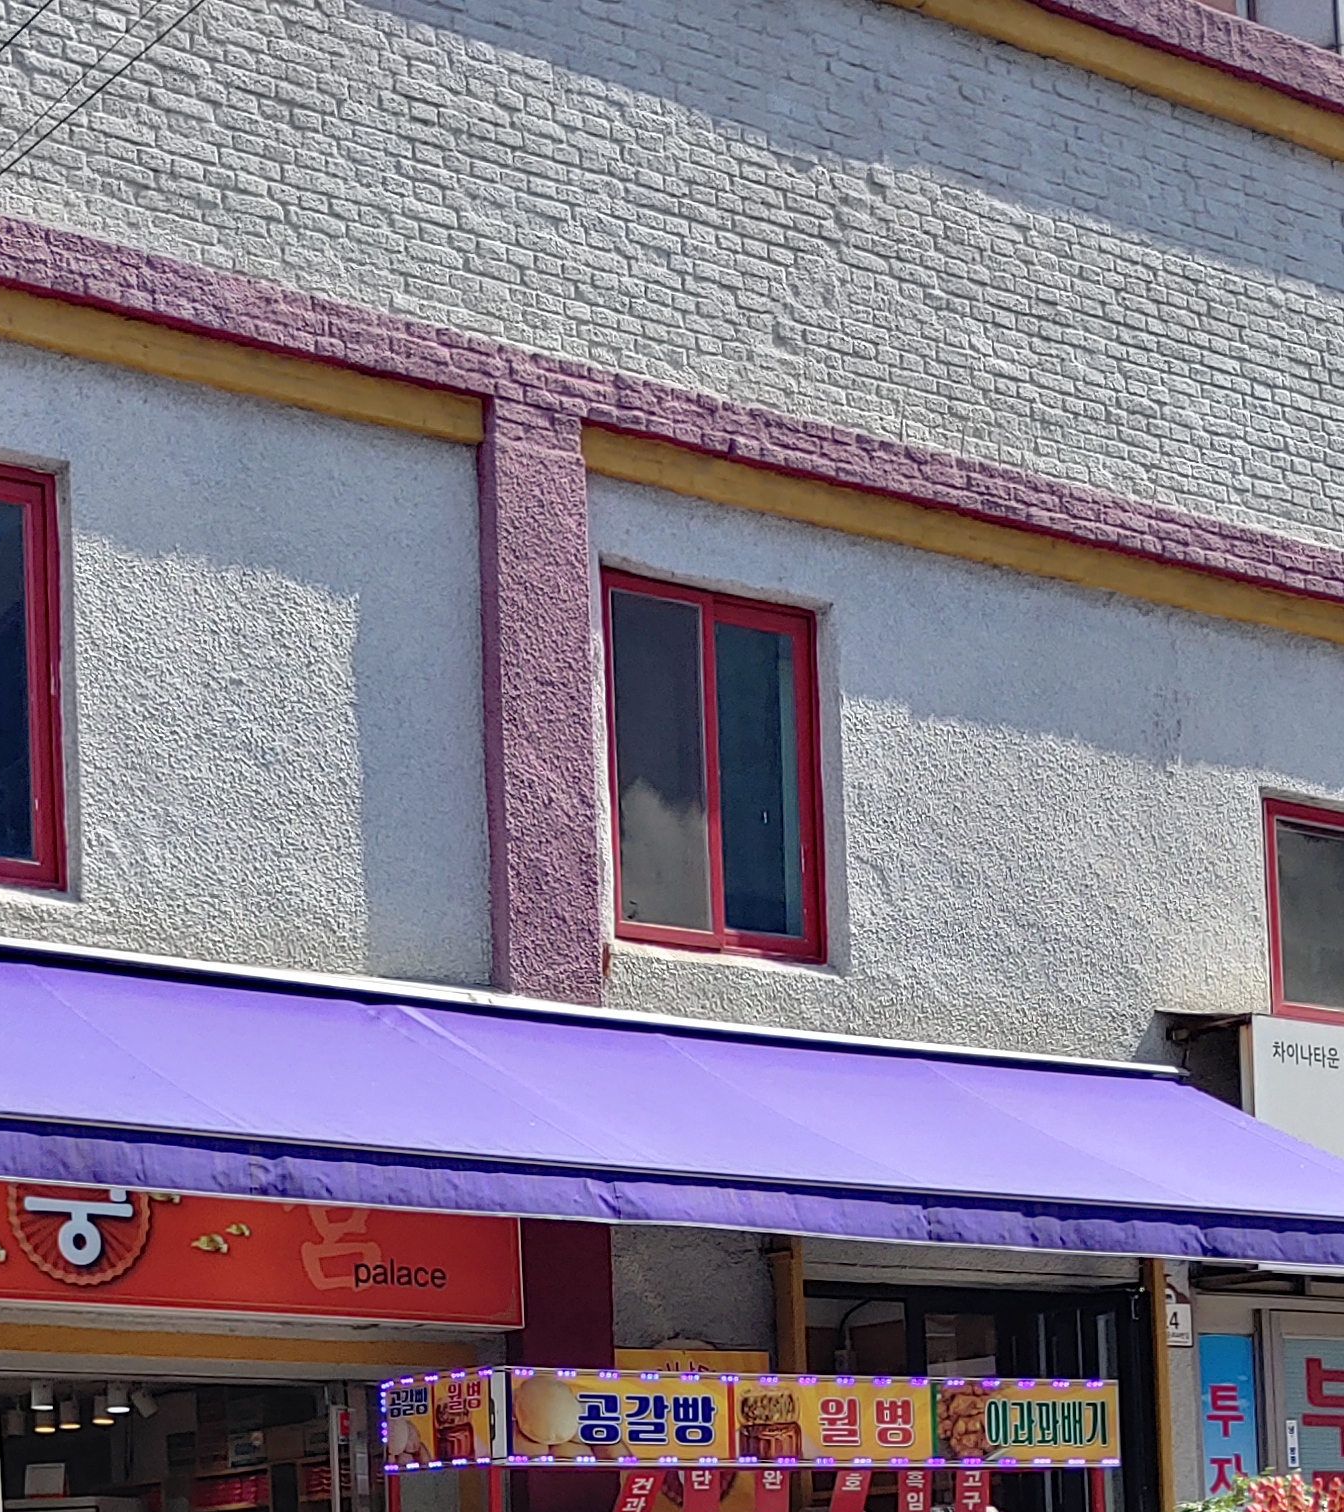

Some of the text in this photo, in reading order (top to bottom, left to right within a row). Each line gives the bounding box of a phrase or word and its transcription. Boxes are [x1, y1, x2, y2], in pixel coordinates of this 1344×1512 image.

[1272, 1041, 1340, 1069] 차이나타운
[355, 1258, 447, 1288] palace
[390, 1387, 429, 1418] 공갈빵
[578, 1392, 718, 1445] 공갈빵
